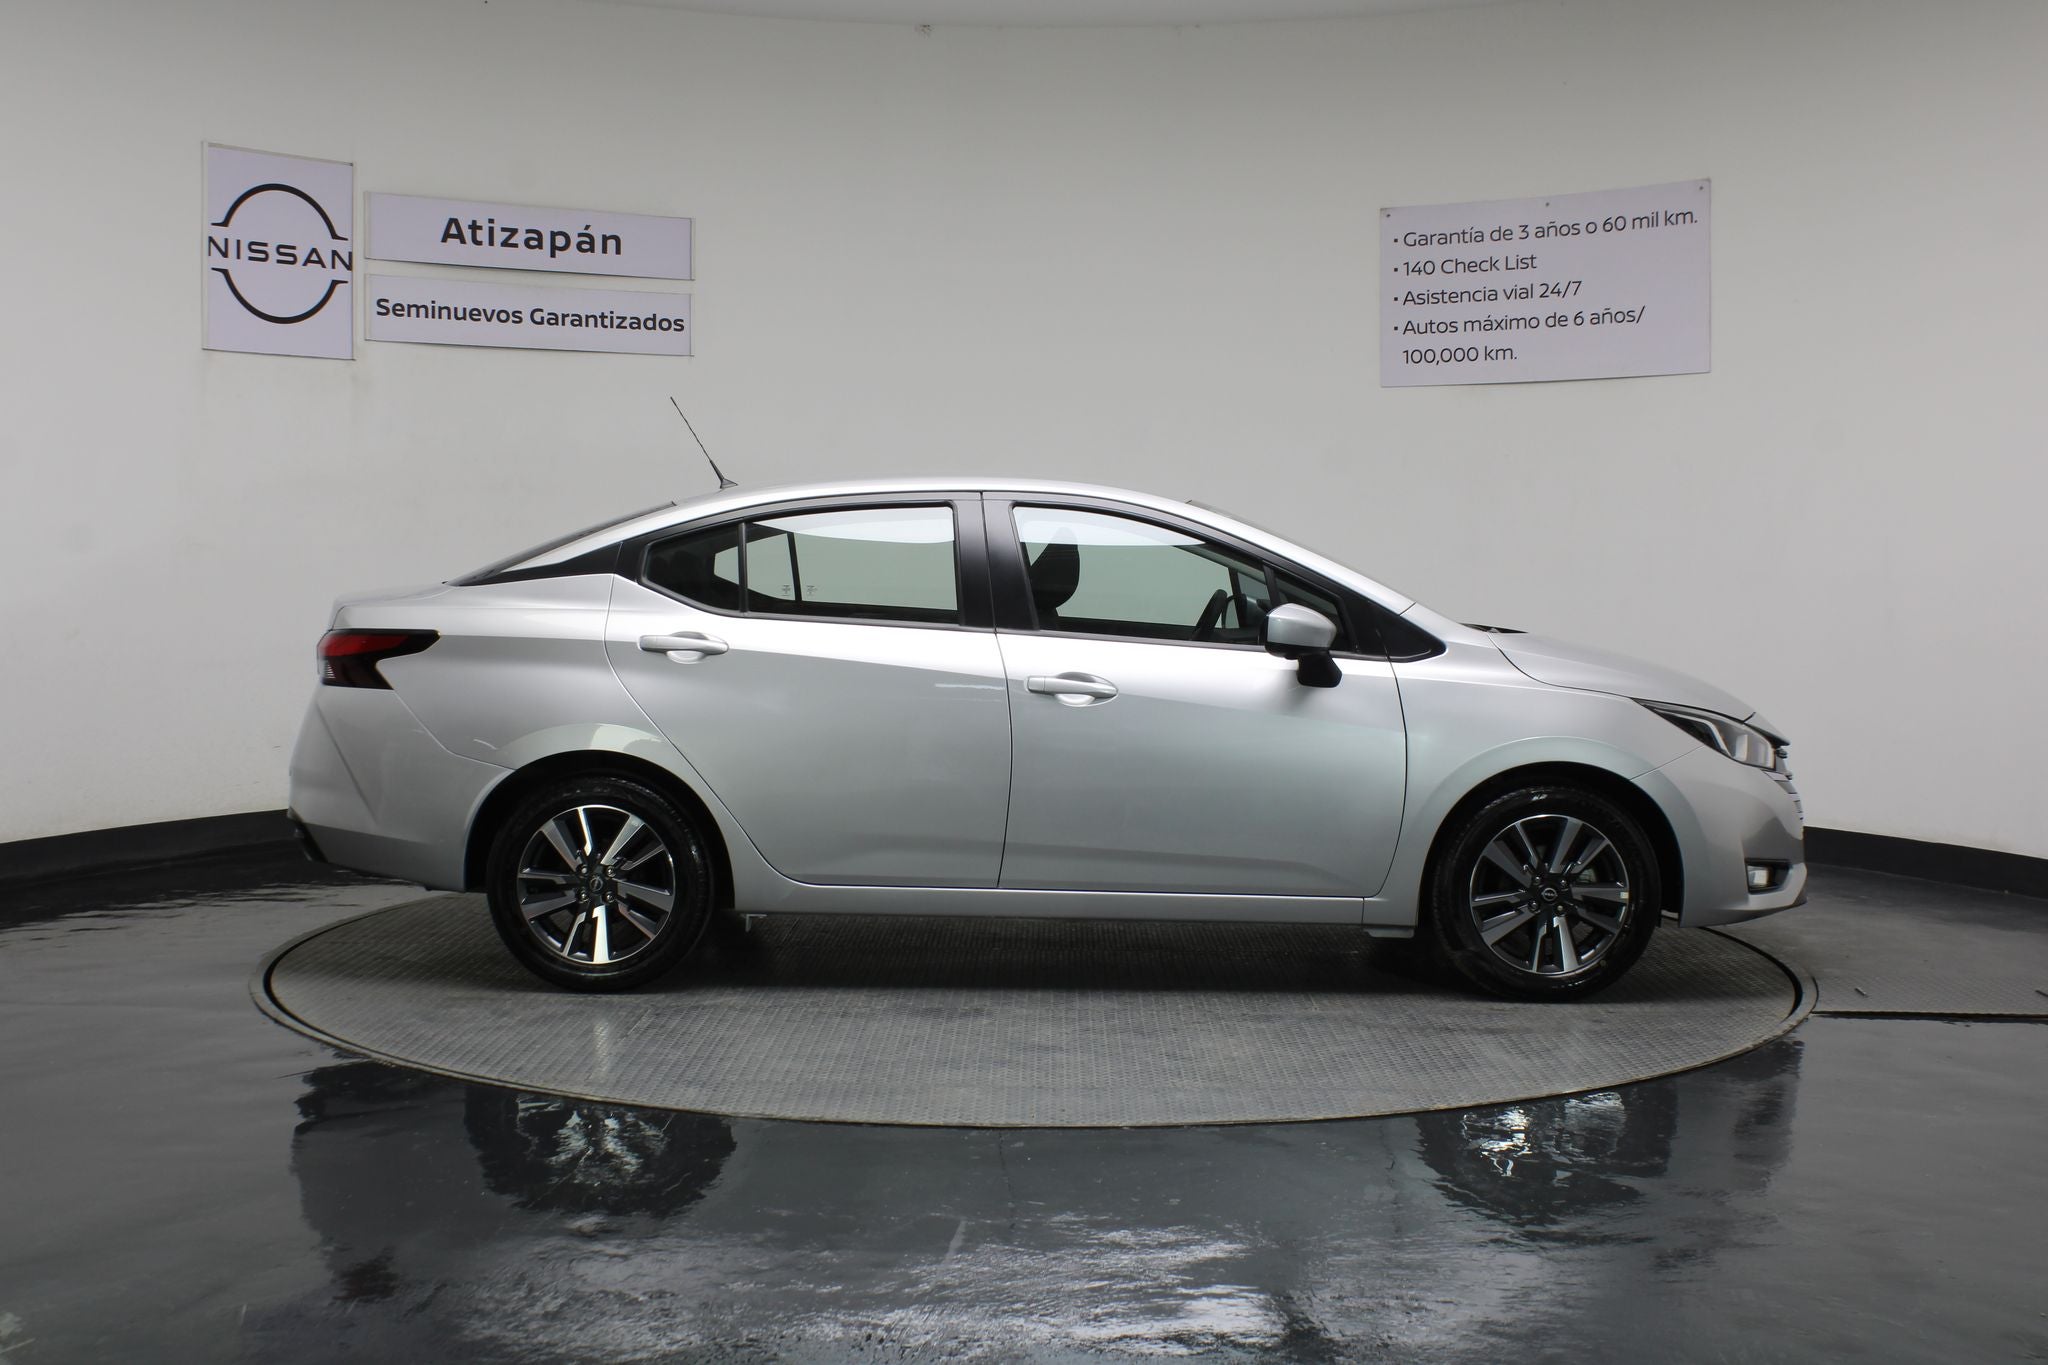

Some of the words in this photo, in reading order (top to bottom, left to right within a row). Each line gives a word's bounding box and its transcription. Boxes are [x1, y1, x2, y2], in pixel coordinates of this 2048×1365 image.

[440, 217, 622, 259] Atizapán
[1403, 226, 1485, 247] Garantía
[1489, 225, 1514, 242] de
[1518, 224, 1530, 240] 3
[1534, 220, 1581, 239] años
[1585, 221, 1598, 235] o
[1602, 215, 1627, 233] 60
[1631, 211, 1659, 230] mil
[1664, 210, 1698, 227] km.
[208, 235, 353, 273] NISSAN
[1402, 260, 1436, 277] 140
[1440, 255, 1500, 275] Check
[1505, 254, 1537, 271] List
[1402, 289, 1498, 306] Asistencia
[1502, 283, 1534, 301] vial
[1538, 280, 1583, 299] 24/7
[376, 298, 524, 325] Seminuevos
[529, 307, 685, 333] Garantizados
[1402, 319, 1459, 336] Autos
[1463, 314, 1540, 333] máximo
[1544, 311, 1569, 328] de
[1573, 310, 1585, 327] 6
[1589, 305, 1646, 326] años/
[1402, 346, 1479, 366] 100,000
[1484, 345, 1518, 361] km.
